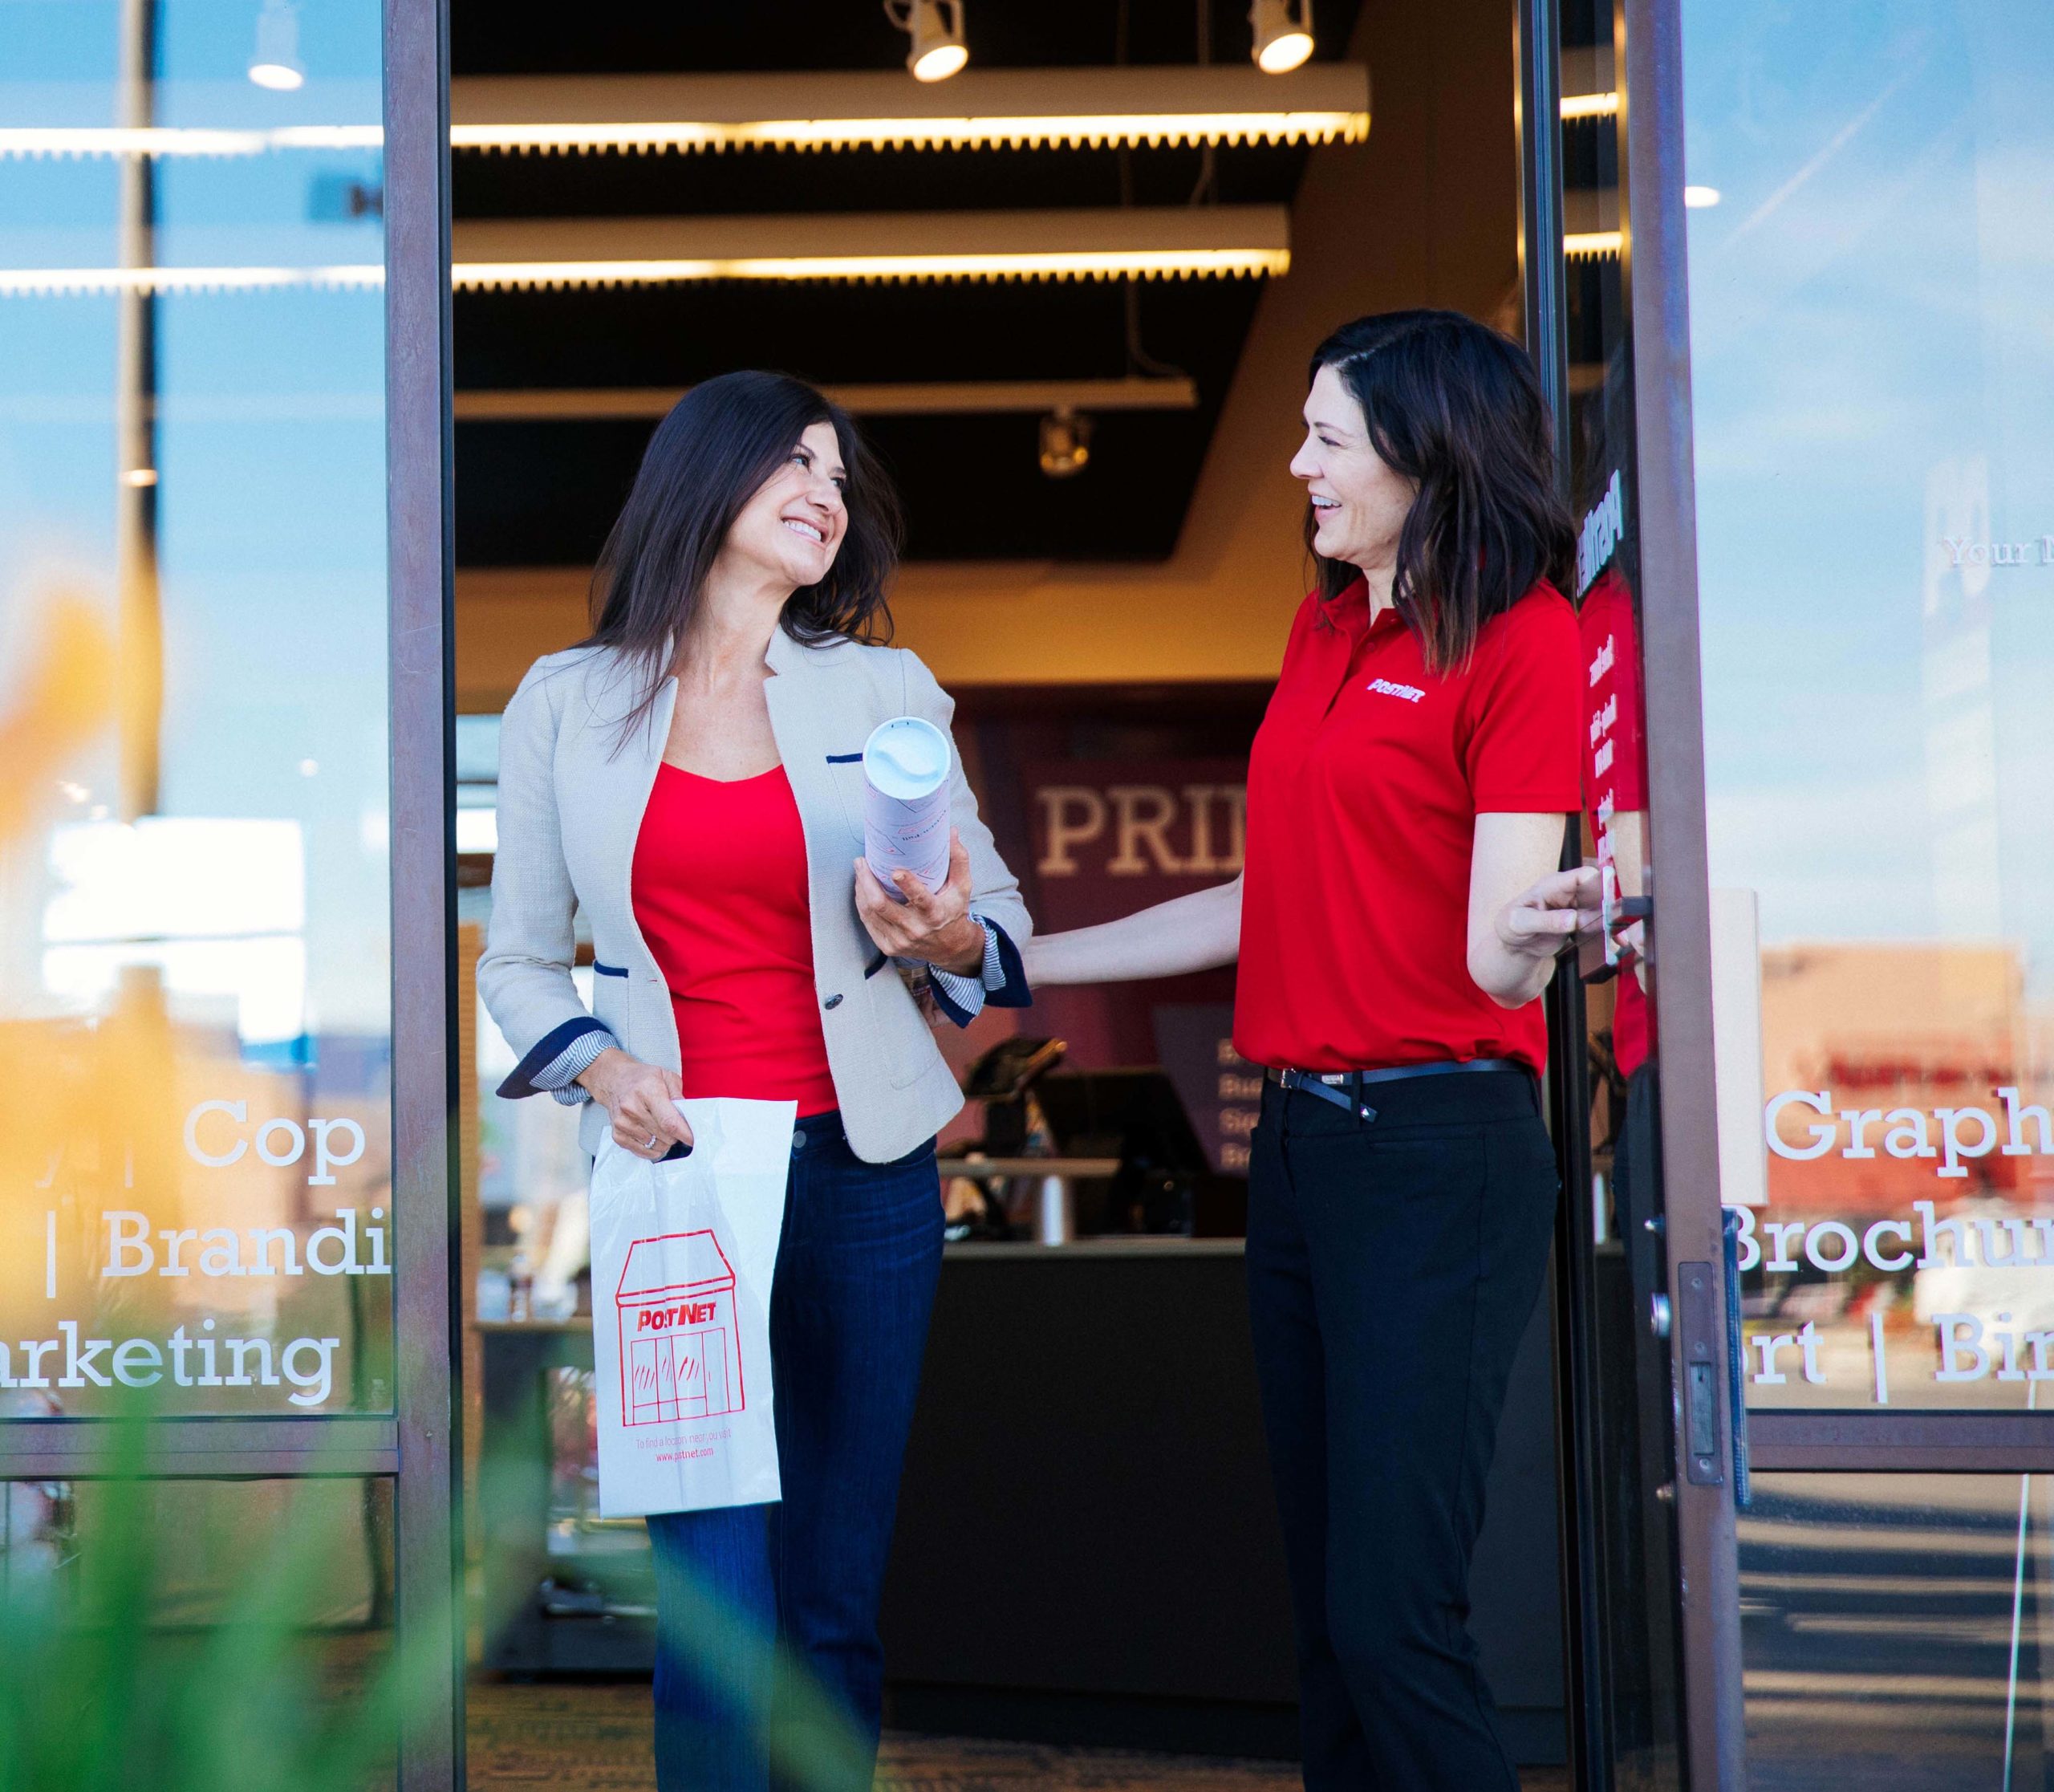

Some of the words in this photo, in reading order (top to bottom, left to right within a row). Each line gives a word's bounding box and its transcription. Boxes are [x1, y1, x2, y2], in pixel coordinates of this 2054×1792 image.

[1943, 536, 2031, 564] Your
[184, 1099, 366, 1185] Cop
[1765, 1087, 2054, 1177] Graph
[102, 1207, 392, 1277] Brandi
[1742, 1320, 1827, 1384] rt
[689, 1432, 704, 1444] near
